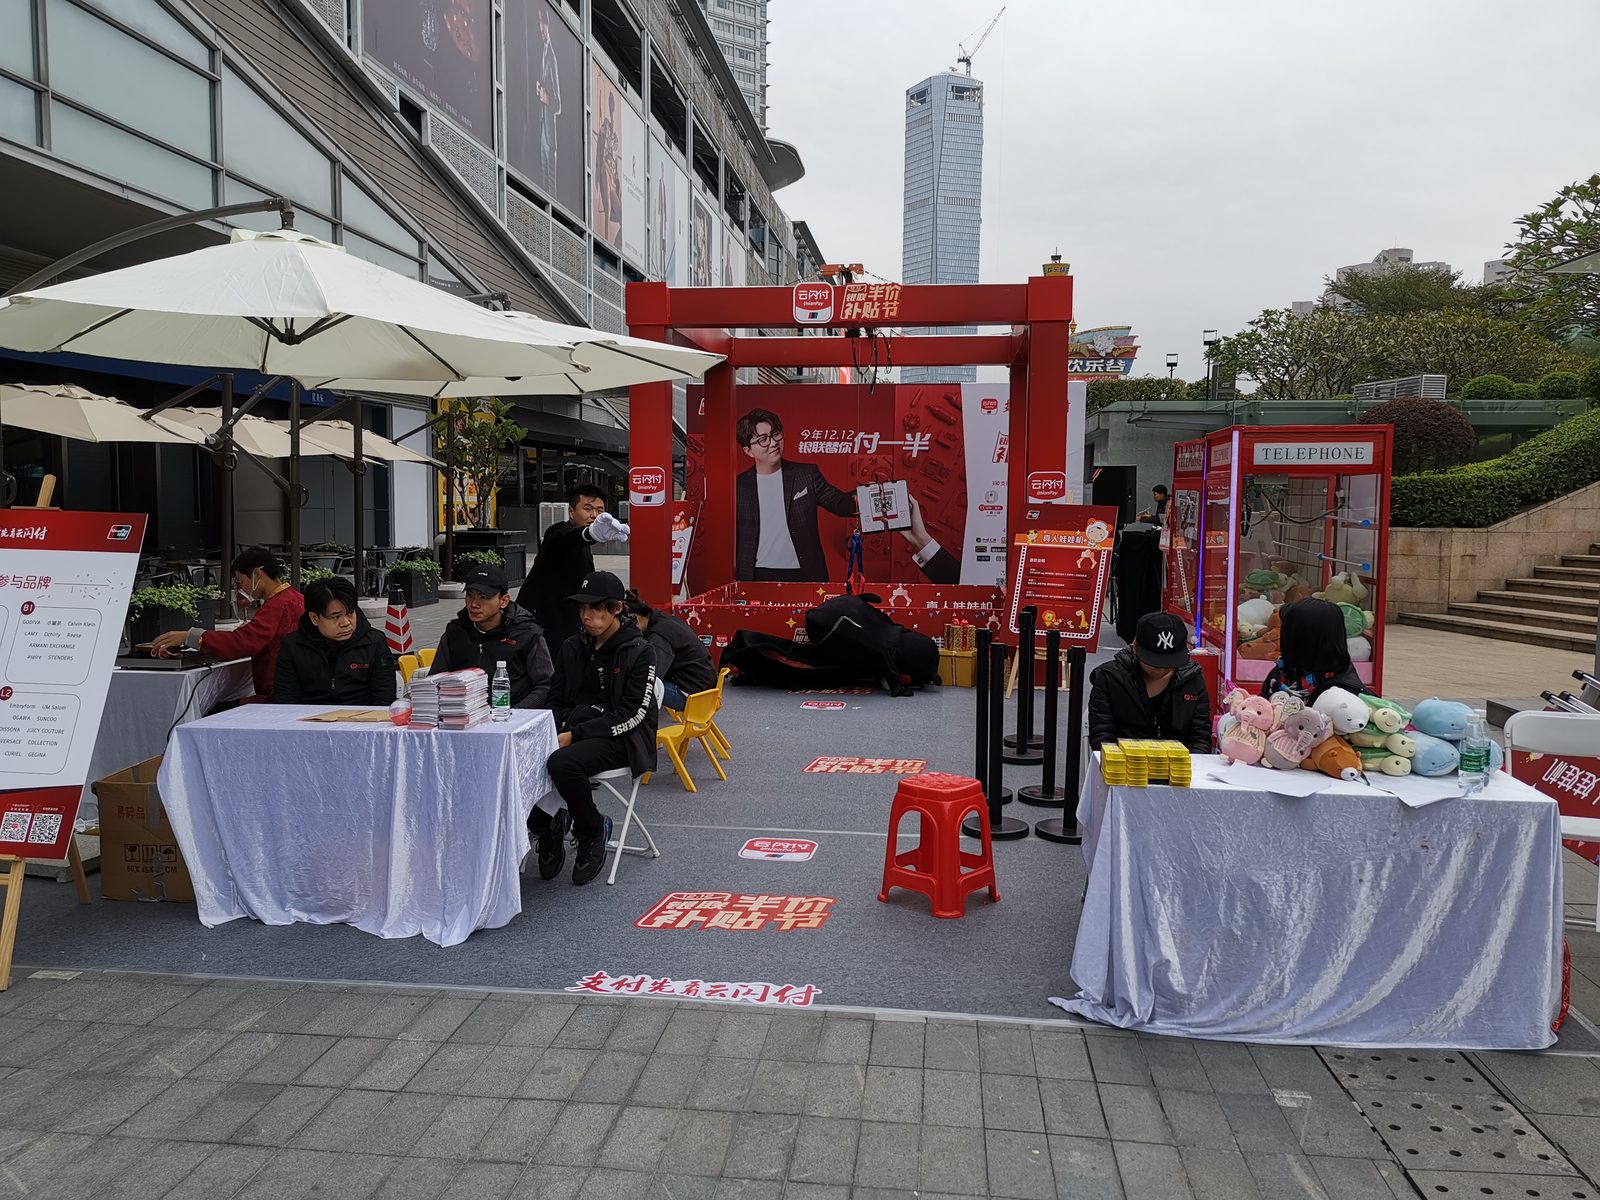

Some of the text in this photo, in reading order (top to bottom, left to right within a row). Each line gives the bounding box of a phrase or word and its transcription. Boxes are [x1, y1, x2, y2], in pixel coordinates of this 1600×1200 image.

[798, 290, 829, 300] 云闪付
[868, 285, 901, 301] 半价
[845, 301, 899, 319] 补贴节
[798, 441, 853, 454] 银联替你
[853, 431, 932, 458] 付一半
[1262, 447, 1365, 461] TELEPHONE
[632, 474, 662, 485] 云闪付
[1031, 479, 1064, 490] 云闪付
[0, 526, 48, 540] 先看云闪付
[1043, 534, 1084, 544] 真人娃娃机
[0, 575, 52, 589] 参与品牌
[581, 579, 588, 588] R
[23, 604, 33, 612] B1
[1157, 631, 1174, 649] NY
[647, 664, 656, 683] THE
[0, 689, 12, 697] L2
[610, 707, 647, 736] UNIVERSE
[753, 840, 811, 850] 云闪付
[732, 895, 834, 913] 半价
[652, 909, 826, 930] 补贴节
[575, 971, 821, 1006] 支付先看云闪付
